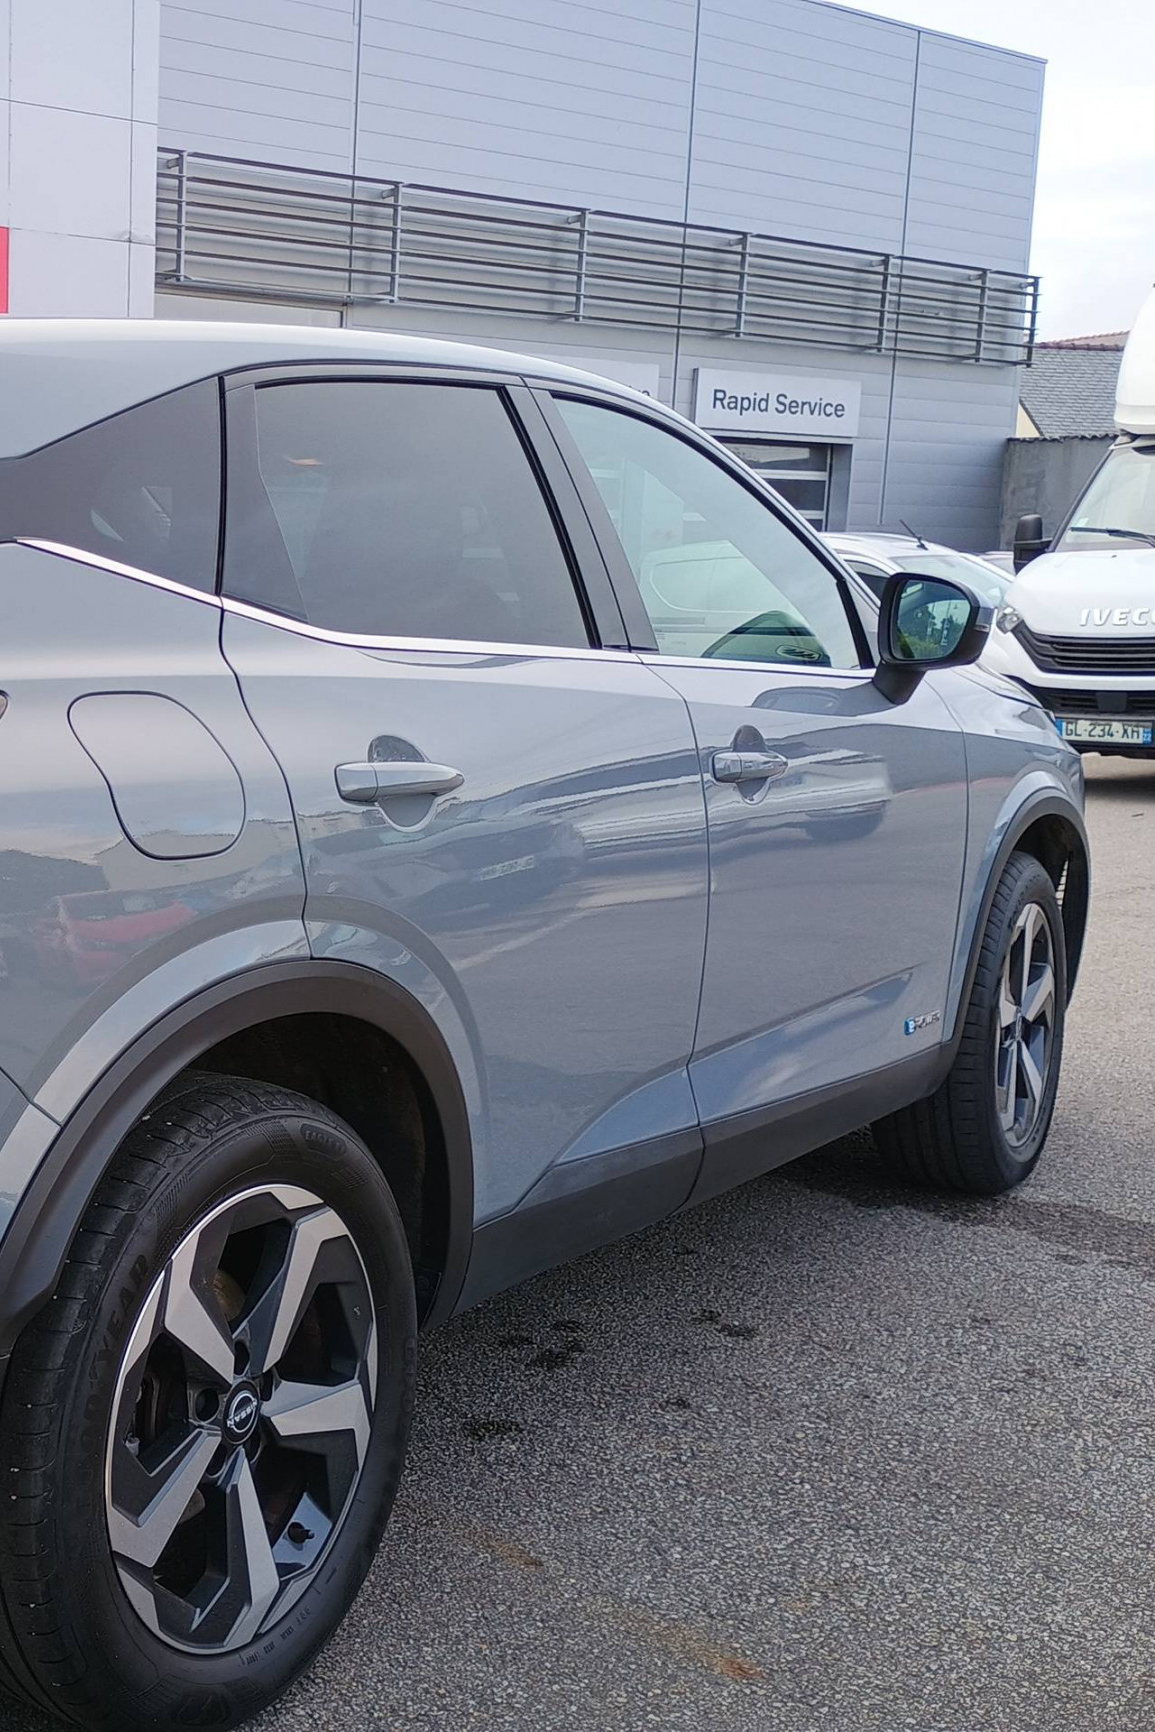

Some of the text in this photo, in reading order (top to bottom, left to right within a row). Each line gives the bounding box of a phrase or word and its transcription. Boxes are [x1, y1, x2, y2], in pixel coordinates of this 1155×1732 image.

[712, 388, 846, 419] Rapid Service
[1078, 606, 1155, 627] IVEC
